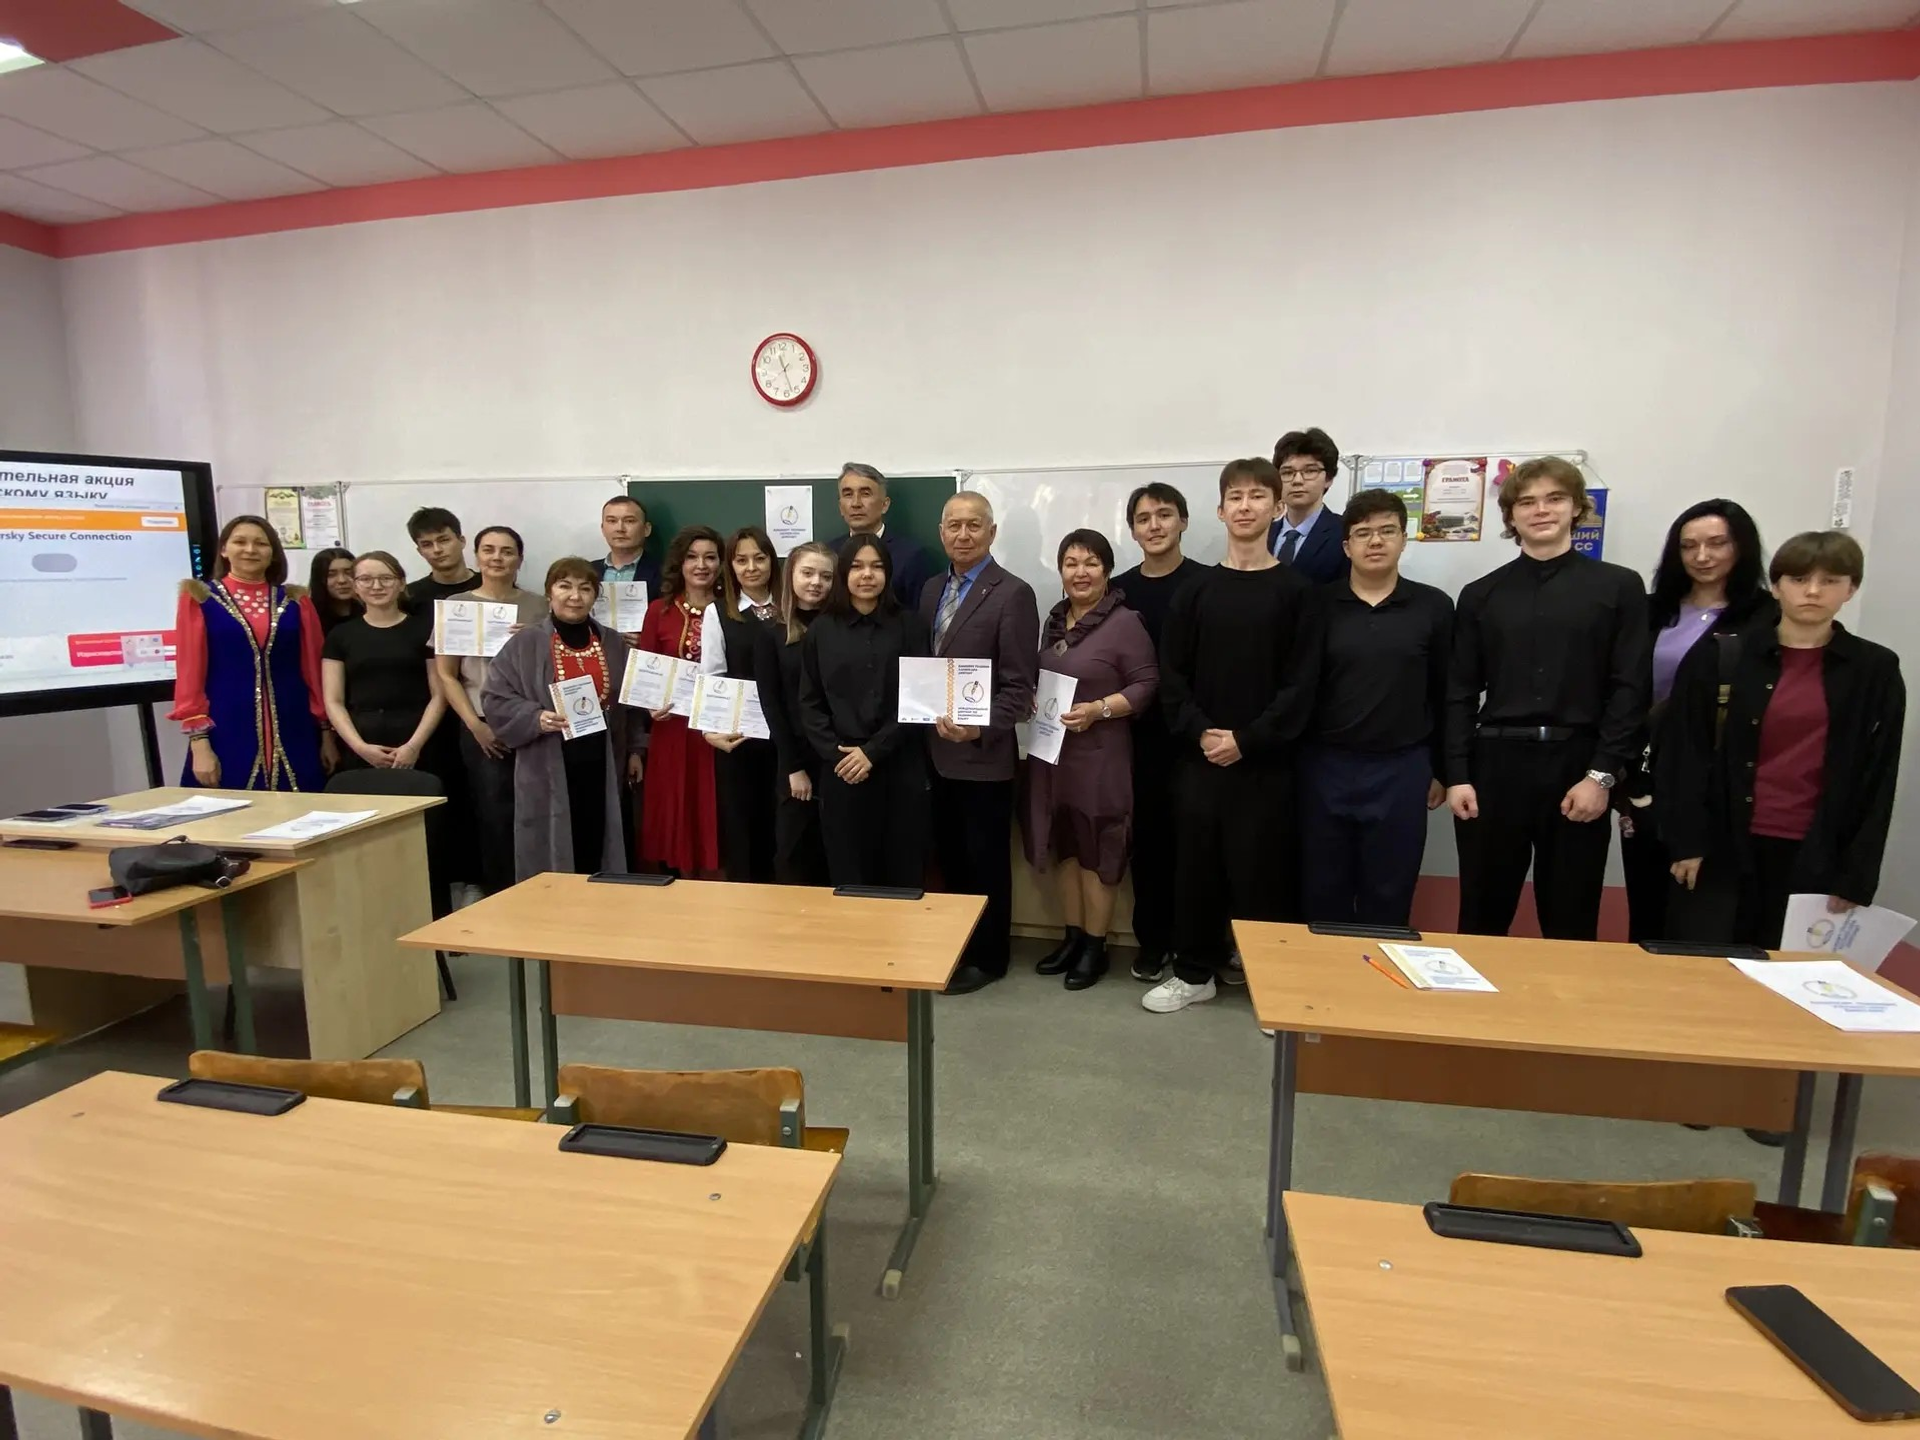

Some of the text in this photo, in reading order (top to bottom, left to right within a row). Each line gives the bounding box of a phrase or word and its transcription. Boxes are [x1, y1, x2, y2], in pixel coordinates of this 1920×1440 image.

[769, 347, 776, 355] 11
[778, 342, 787, 351] 12
[763, 355, 771, 364] 10
[799, 352, 805, 361] 2
[761, 368, 767, 377] 9
[802, 364, 809, 373] 3
[765, 380, 772, 388] 8
[801, 376, 807, 384] 4
[773, 387, 779, 396] 7
[784, 390, 790, 398] 6
[794, 385, 800, 394] 5
[85, 475, 134, 487] акция
[0, 488, 48, 498] кому
[28, 531, 67, 541] Secure
[69, 532, 133, 541] Connection
